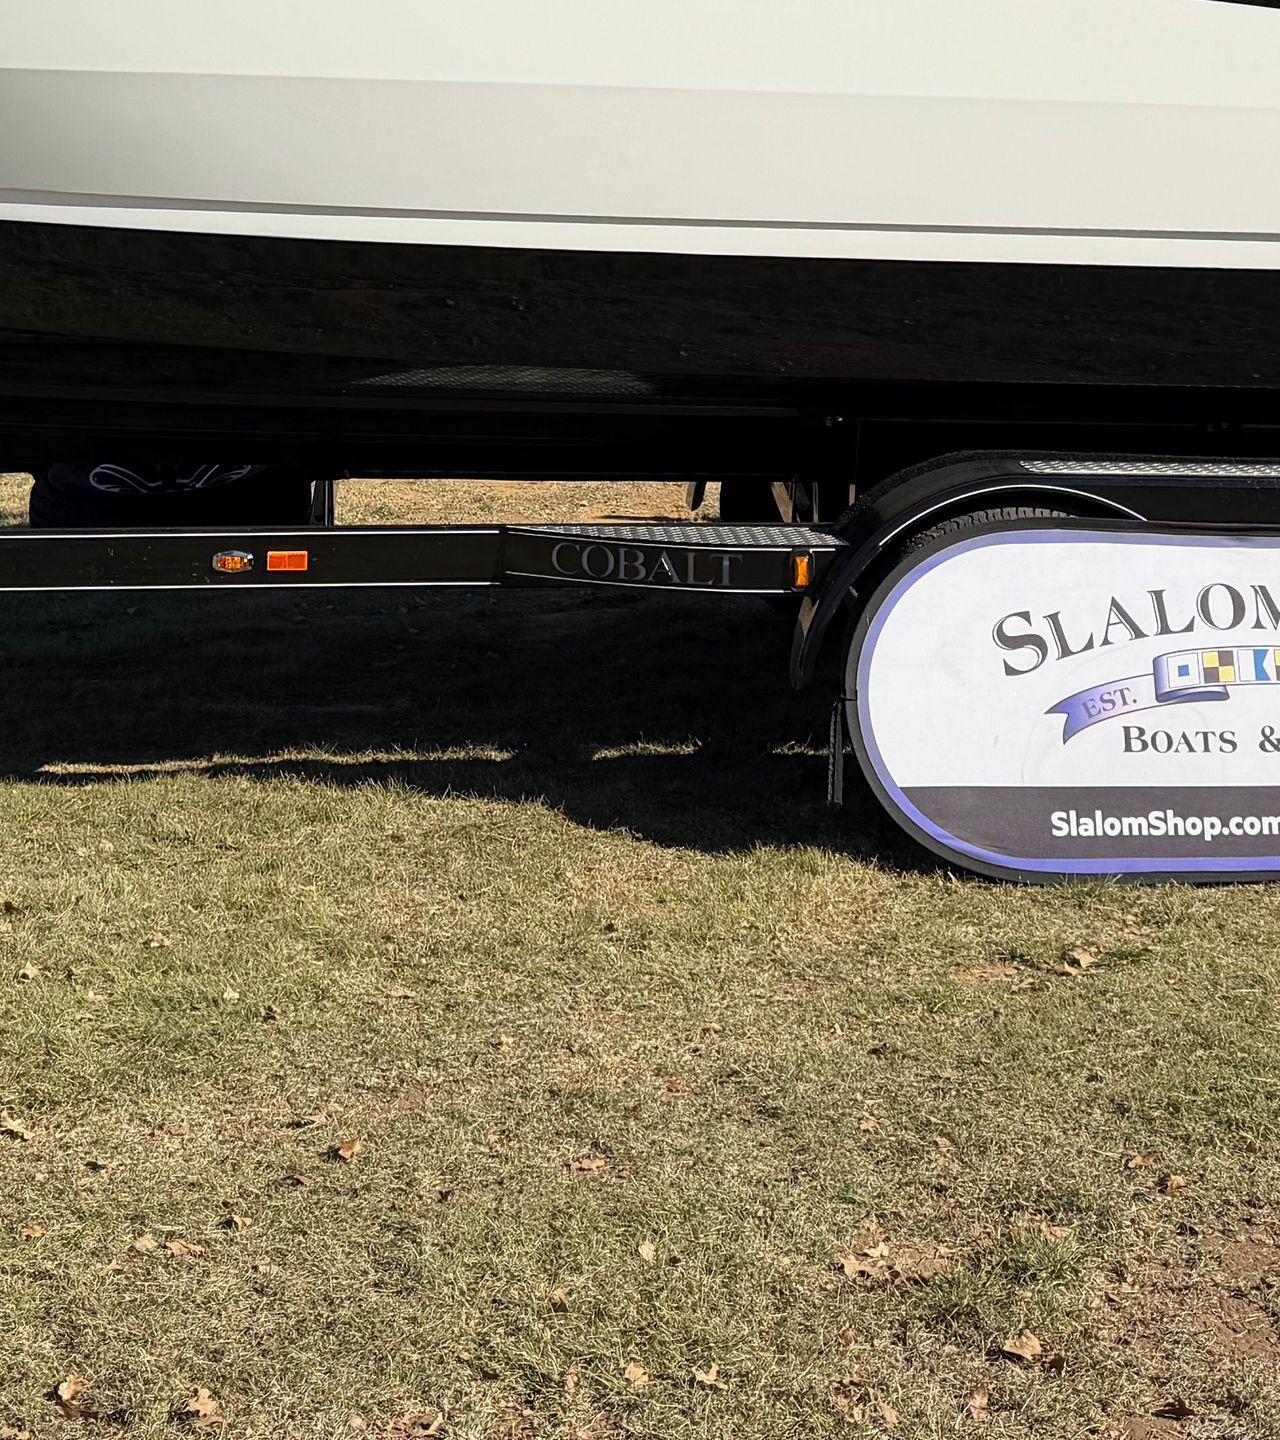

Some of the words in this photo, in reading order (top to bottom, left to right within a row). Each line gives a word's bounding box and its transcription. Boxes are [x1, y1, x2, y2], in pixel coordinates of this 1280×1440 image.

[551, 542, 743, 586] COBALT
[1081, 688, 1139, 720] EST.
[1122, 725, 1238, 755] BOATS
